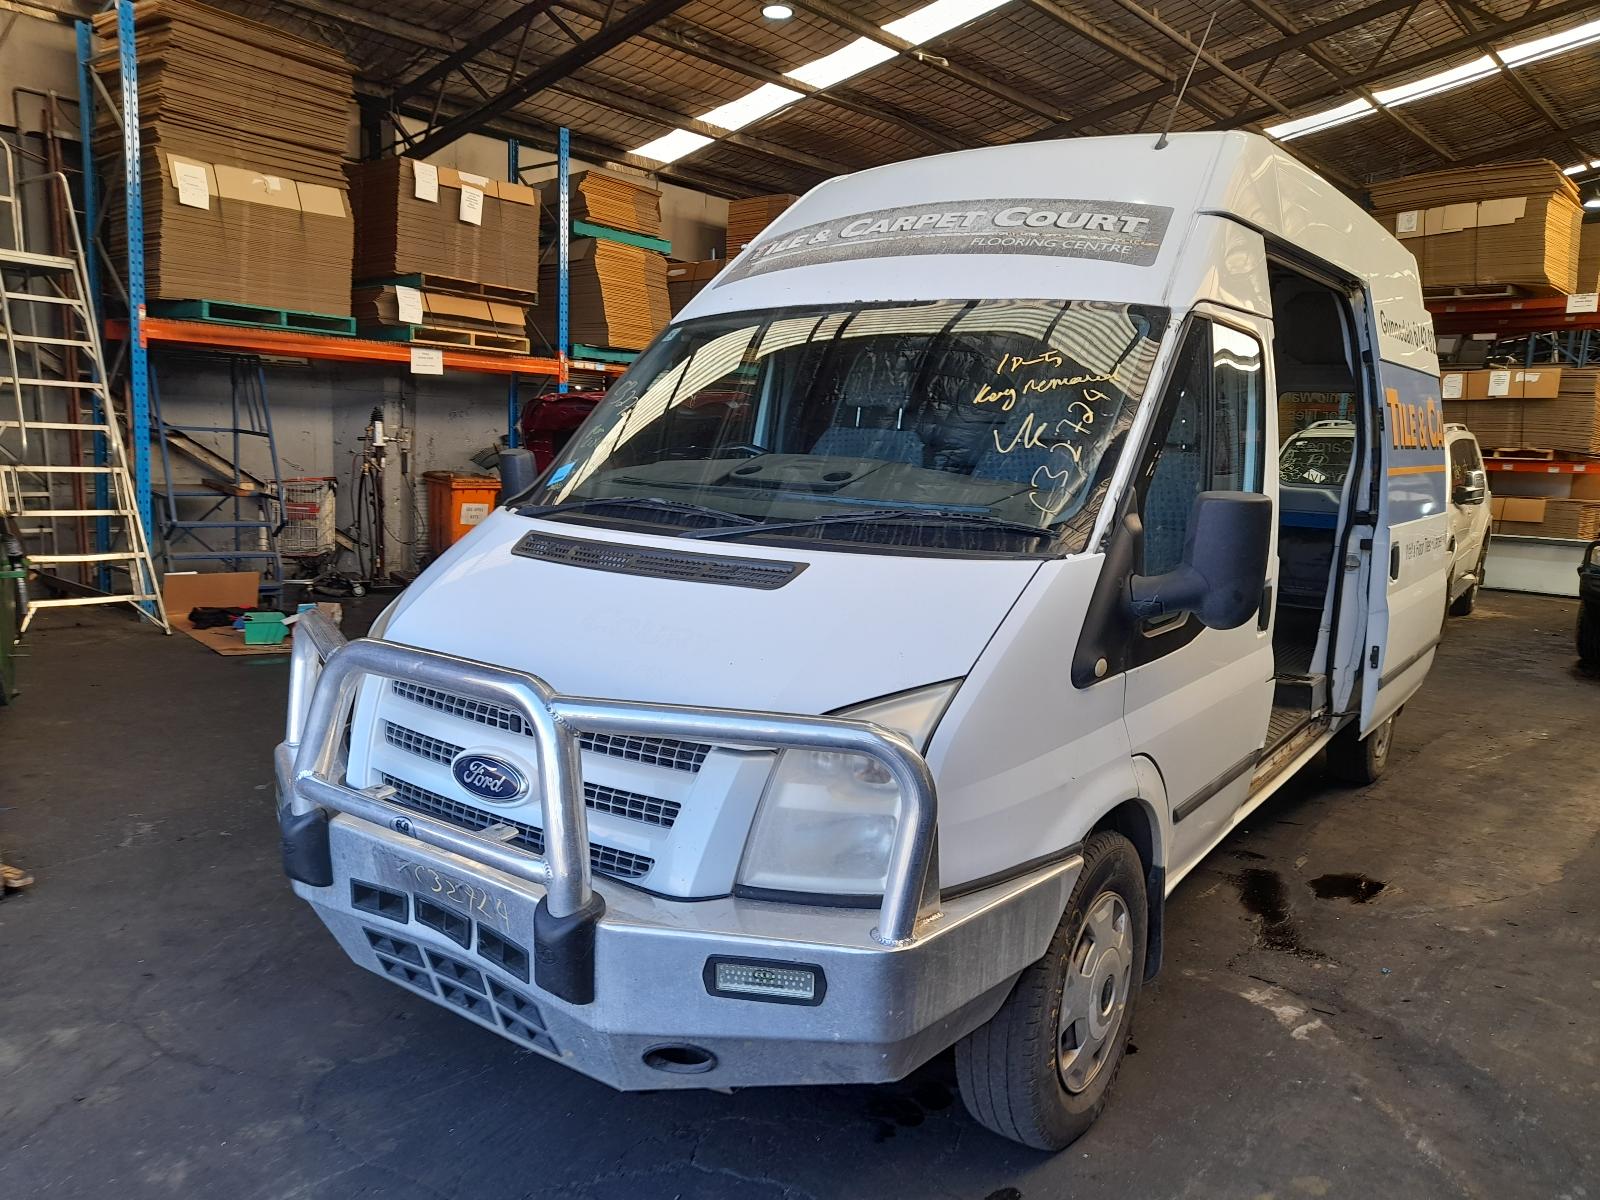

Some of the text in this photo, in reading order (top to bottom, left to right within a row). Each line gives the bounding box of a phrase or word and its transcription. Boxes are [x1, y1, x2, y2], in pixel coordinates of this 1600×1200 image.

[807, 229, 832, 246] &
[838, 211, 985, 239] CARPET
[993, 207, 1150, 233] COURT
[970, 237, 1133, 254] FLOORING CENTRE
[1385, 388, 1417, 450] TILE
[1418, 405, 1428, 450] &
[463, 760, 504, 793] Ford
